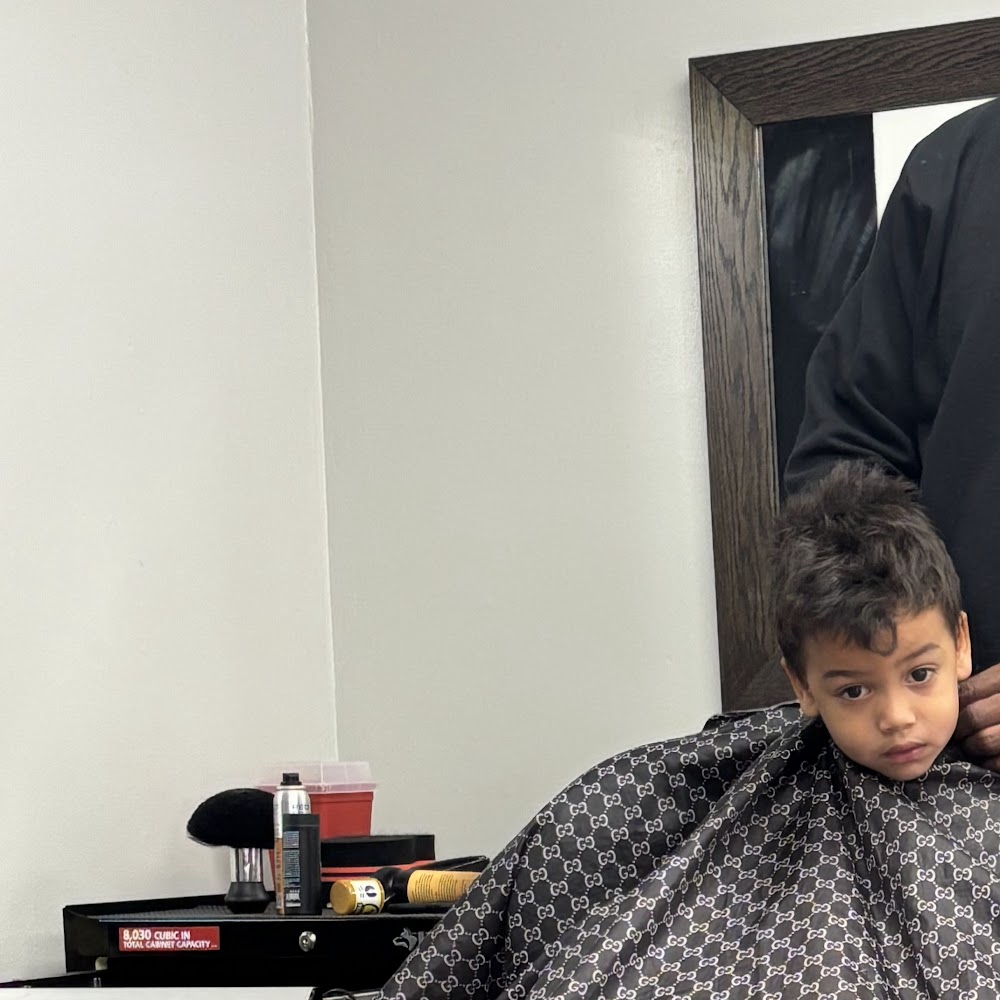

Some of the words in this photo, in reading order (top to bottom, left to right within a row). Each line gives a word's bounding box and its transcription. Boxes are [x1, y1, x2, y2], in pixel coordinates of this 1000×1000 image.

[123, 929, 152, 942] 8,030
[154, 931, 179, 940] CUBIC
[181, 930, 191, 940] IN
[123, 940, 144, 949] TOTAL
[145, 940, 175, 949] CABINET
[176, 940, 211, 949] CAPACITY
